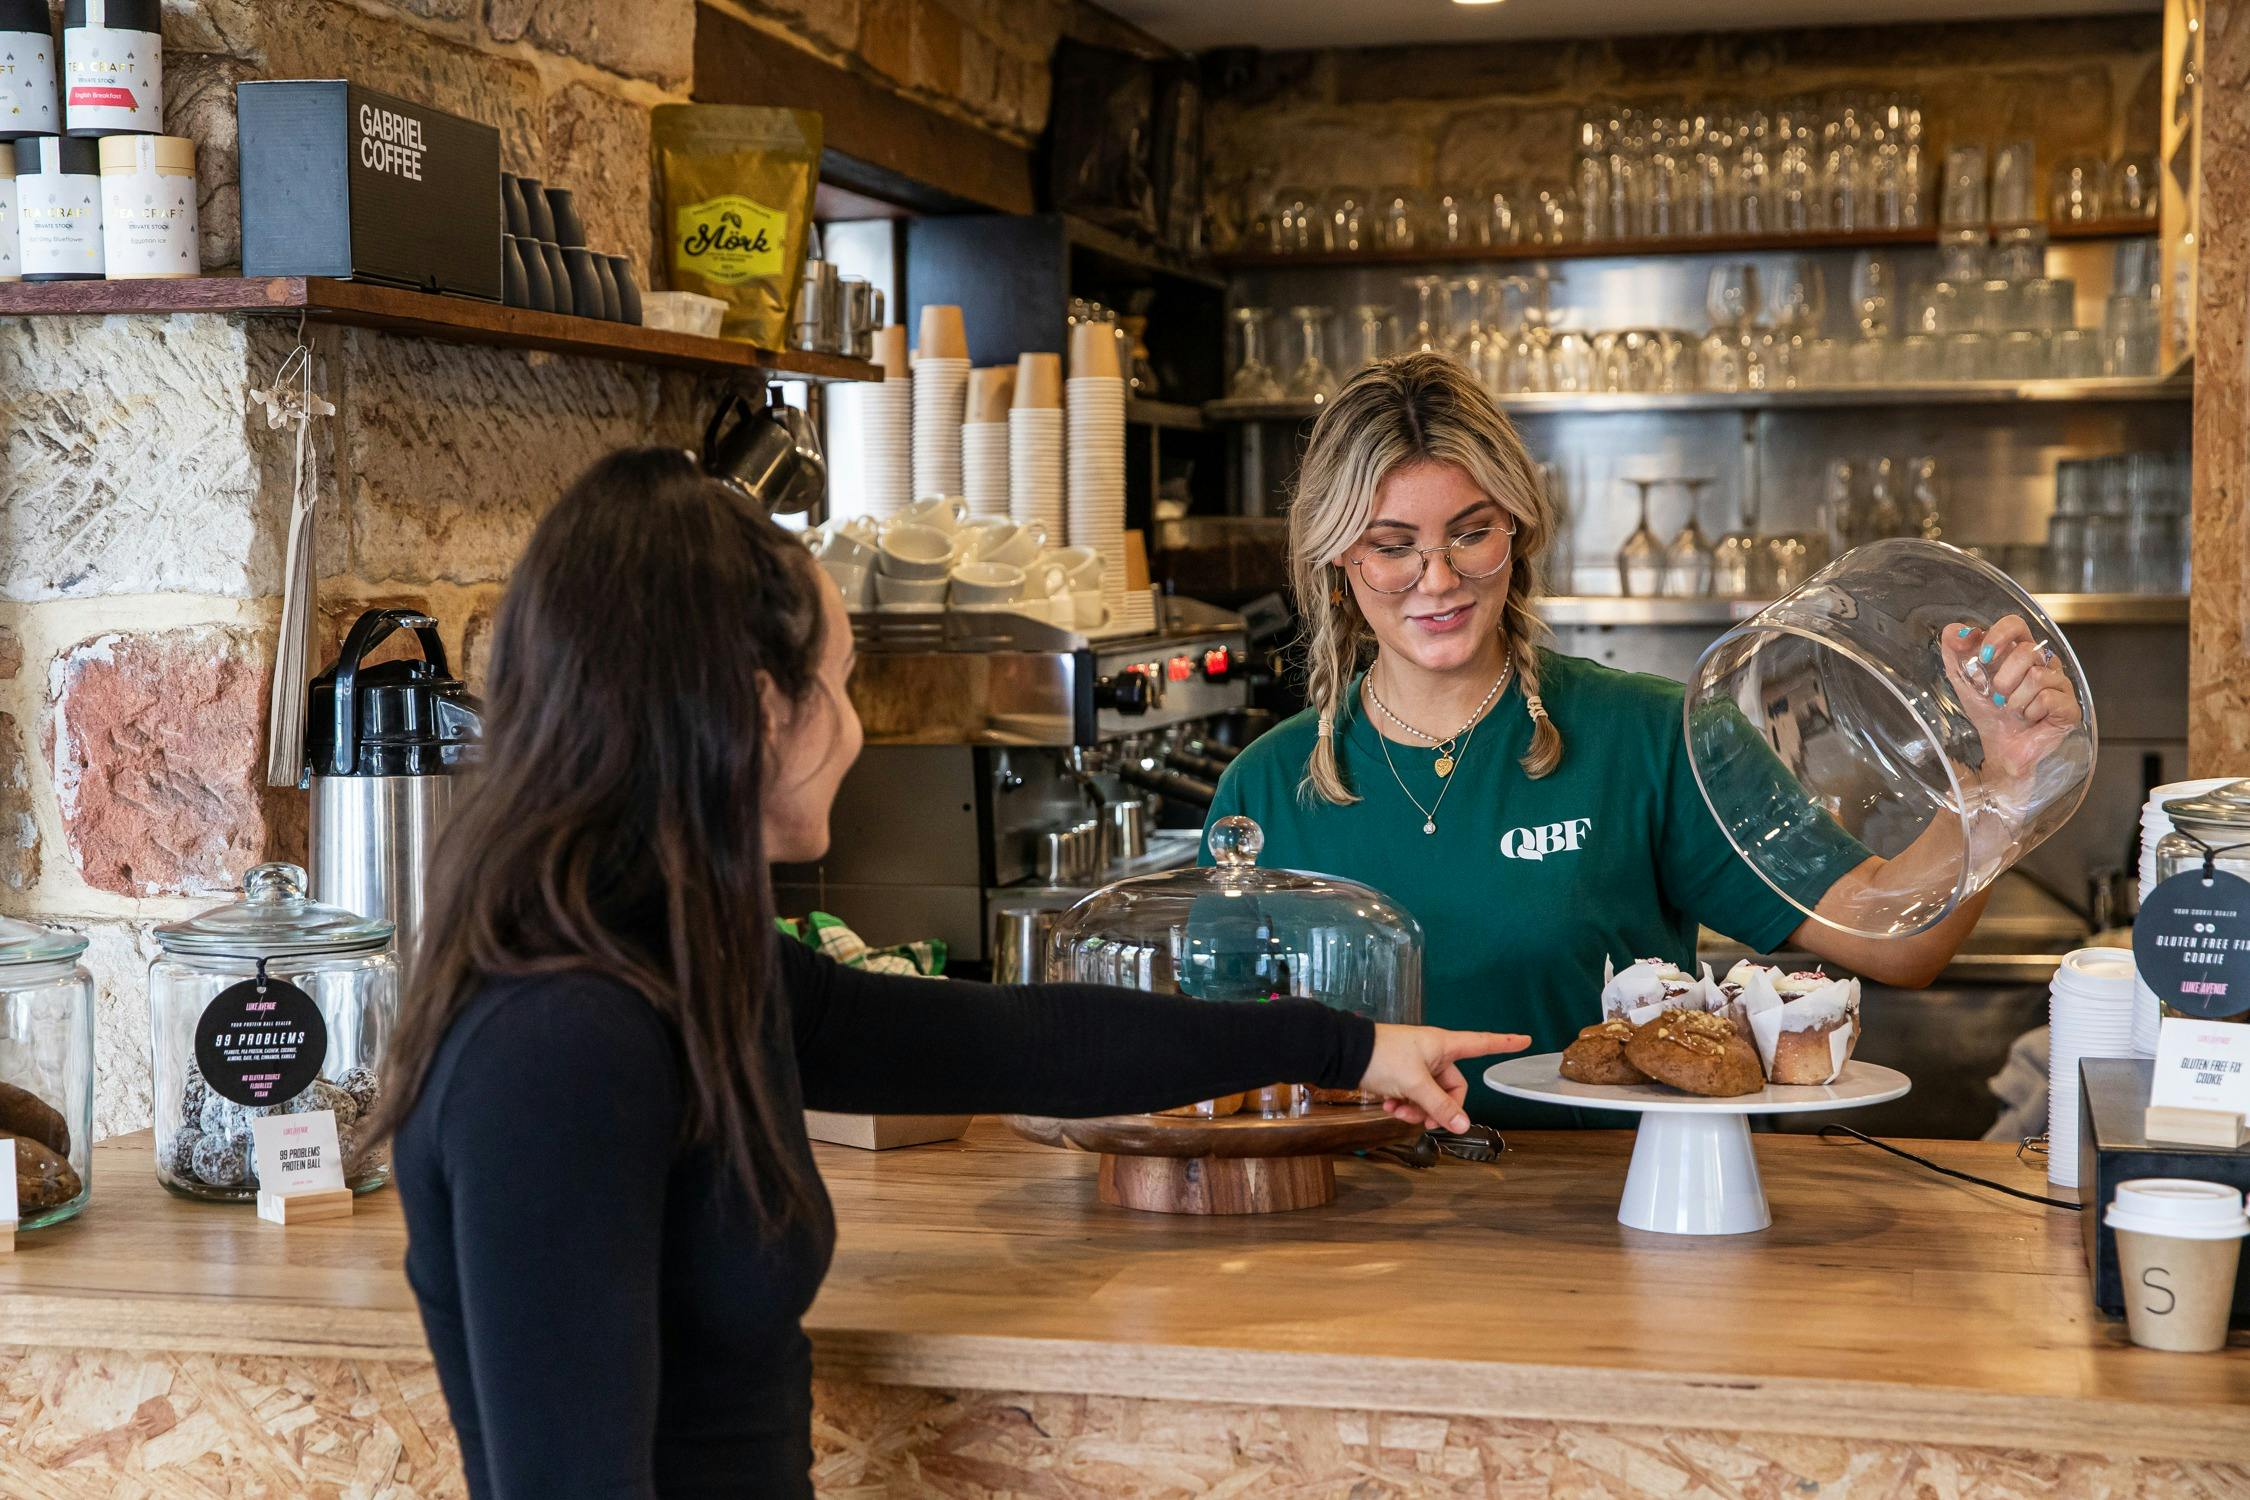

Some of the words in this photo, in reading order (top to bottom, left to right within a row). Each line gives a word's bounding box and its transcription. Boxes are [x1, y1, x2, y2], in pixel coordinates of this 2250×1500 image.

[90, 62, 135, 74] CRAFT
[93, 92, 123, 100] Breakfast
[359, 103, 427, 152] GABRIEL
[360, 136, 422, 182] COFFEE
[1500, 817, 1592, 862] QBF
[2156, 934, 2198, 948] GLUTEN
[2201, 937, 2229, 950] FREE
[2183, 951, 2225, 965] COOKIE
[2181, 981, 2200, 994] LUKE
[2200, 982, 2228, 995] AVENUE
[215, 1034, 231, 1047] 99
[238, 1031, 305, 1046] PROBLEMS
[2180, 1057, 2209, 1071] GLUTEN
[2210, 1059, 2228, 1072] FREE
[2229, 1061, 2243, 1073] FIX
[2195, 1072, 2224, 1085] COOKIE
[279, 1149, 288, 1161] 99
[289, 1145, 321, 1160] PROBLEMS
[281, 1160, 306, 1172] PROTEIN
[307, 1157, 321, 1170] BALL
[2142, 1266, 2176, 1316] S
